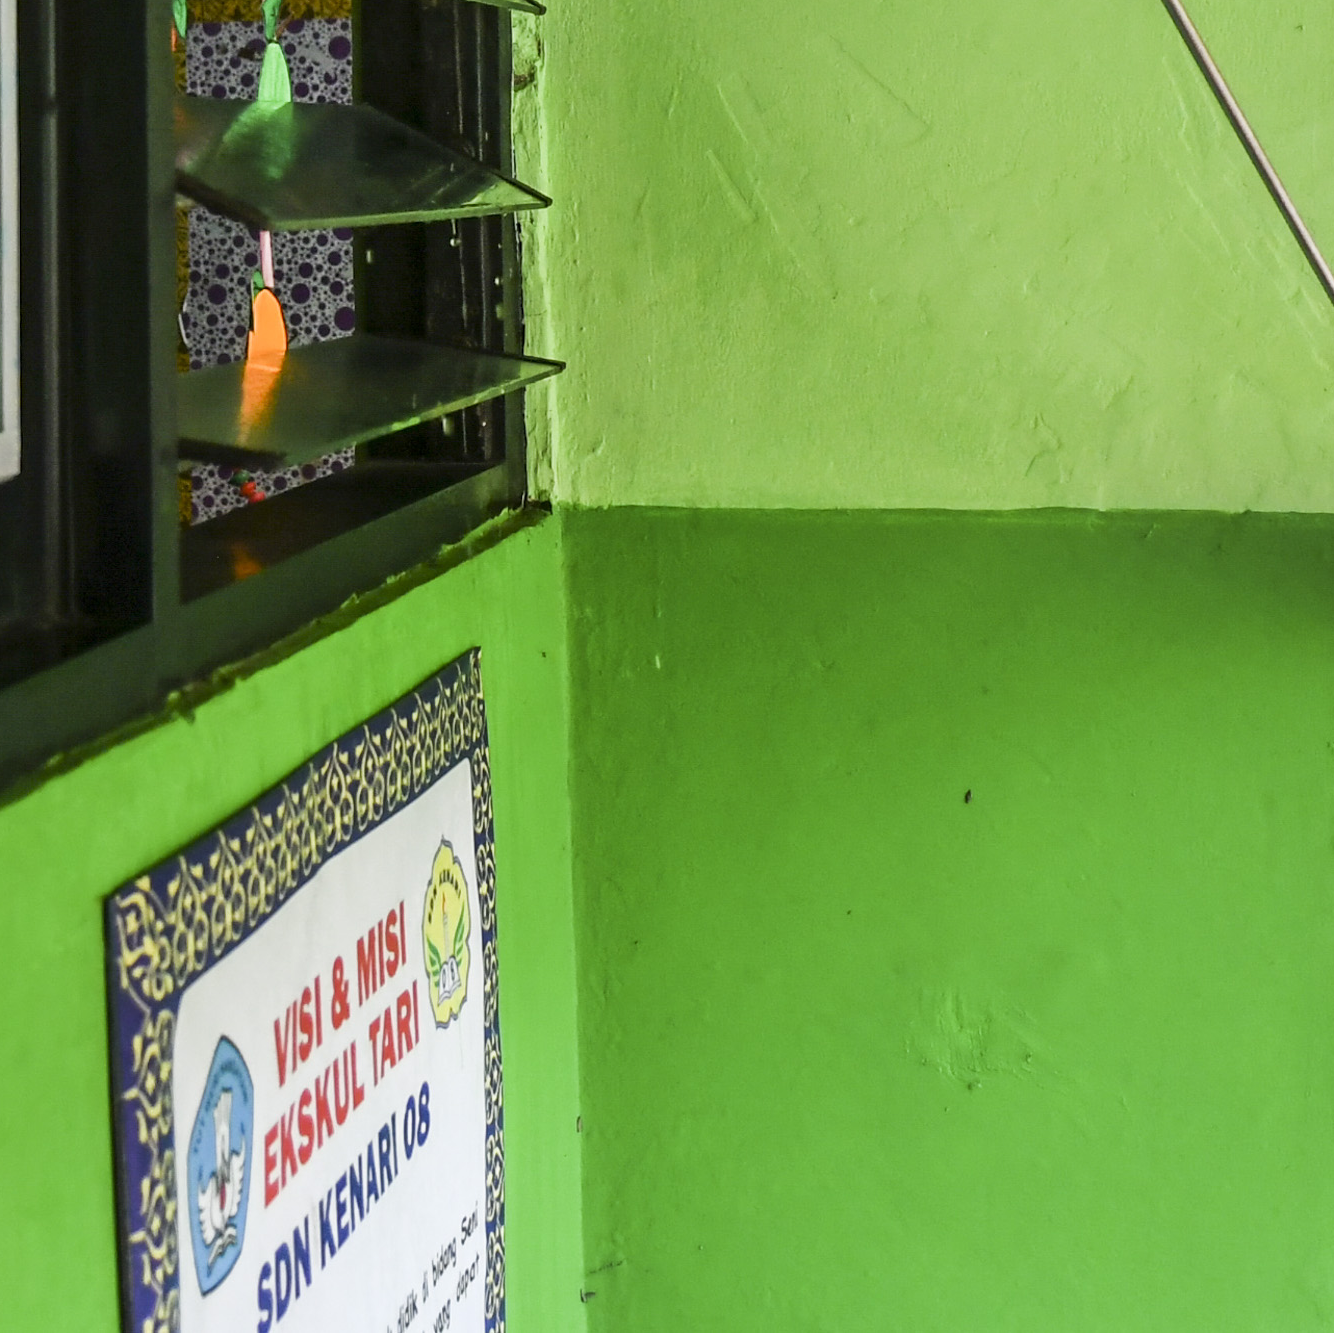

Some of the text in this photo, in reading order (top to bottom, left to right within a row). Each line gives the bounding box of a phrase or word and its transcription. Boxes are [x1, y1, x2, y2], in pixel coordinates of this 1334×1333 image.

[274, 974, 323, 1088] VISI
[331, 955, 350, 1031] &
[356, 899, 407, 1008] MISI
[264, 979, 420, 1209] EKSKUL TARI
[256, 1080, 431, 1333] SDN KENARI 08
[422, 1269, 429, 1304] di
[431, 1236, 456, 1287] bidang
[460, 1199, 479, 1246] Seni
[456, 1251, 480, 1302] dapat
